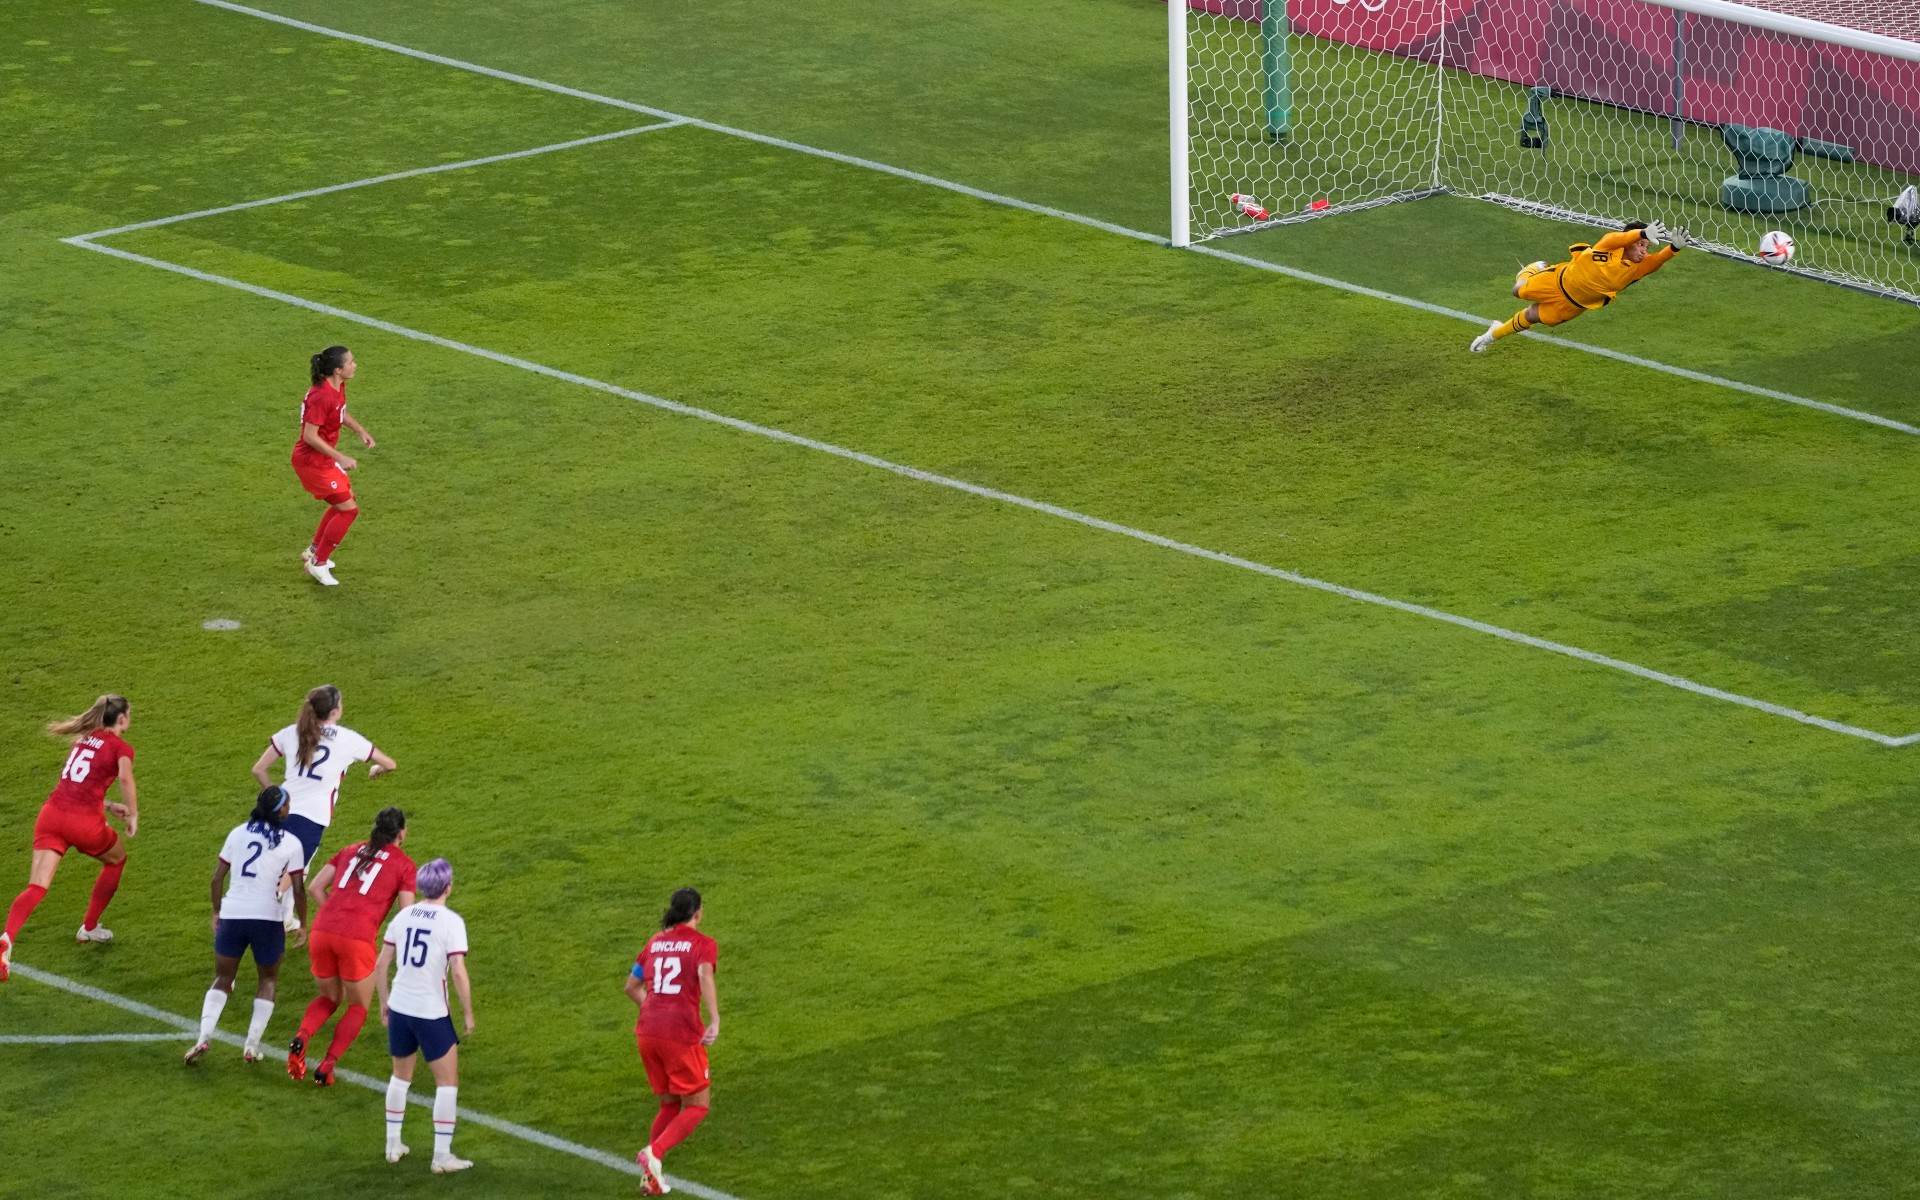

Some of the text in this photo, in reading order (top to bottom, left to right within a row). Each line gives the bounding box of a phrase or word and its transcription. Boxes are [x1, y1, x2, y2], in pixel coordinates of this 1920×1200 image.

[1592, 251, 1608, 262] 18
[61, 747, 95, 783] 16
[241, 841, 263, 877] 2
[338, 856, 382, 895] 14
[403, 928, 431, 968] 15
[653, 957, 682, 994] 12
